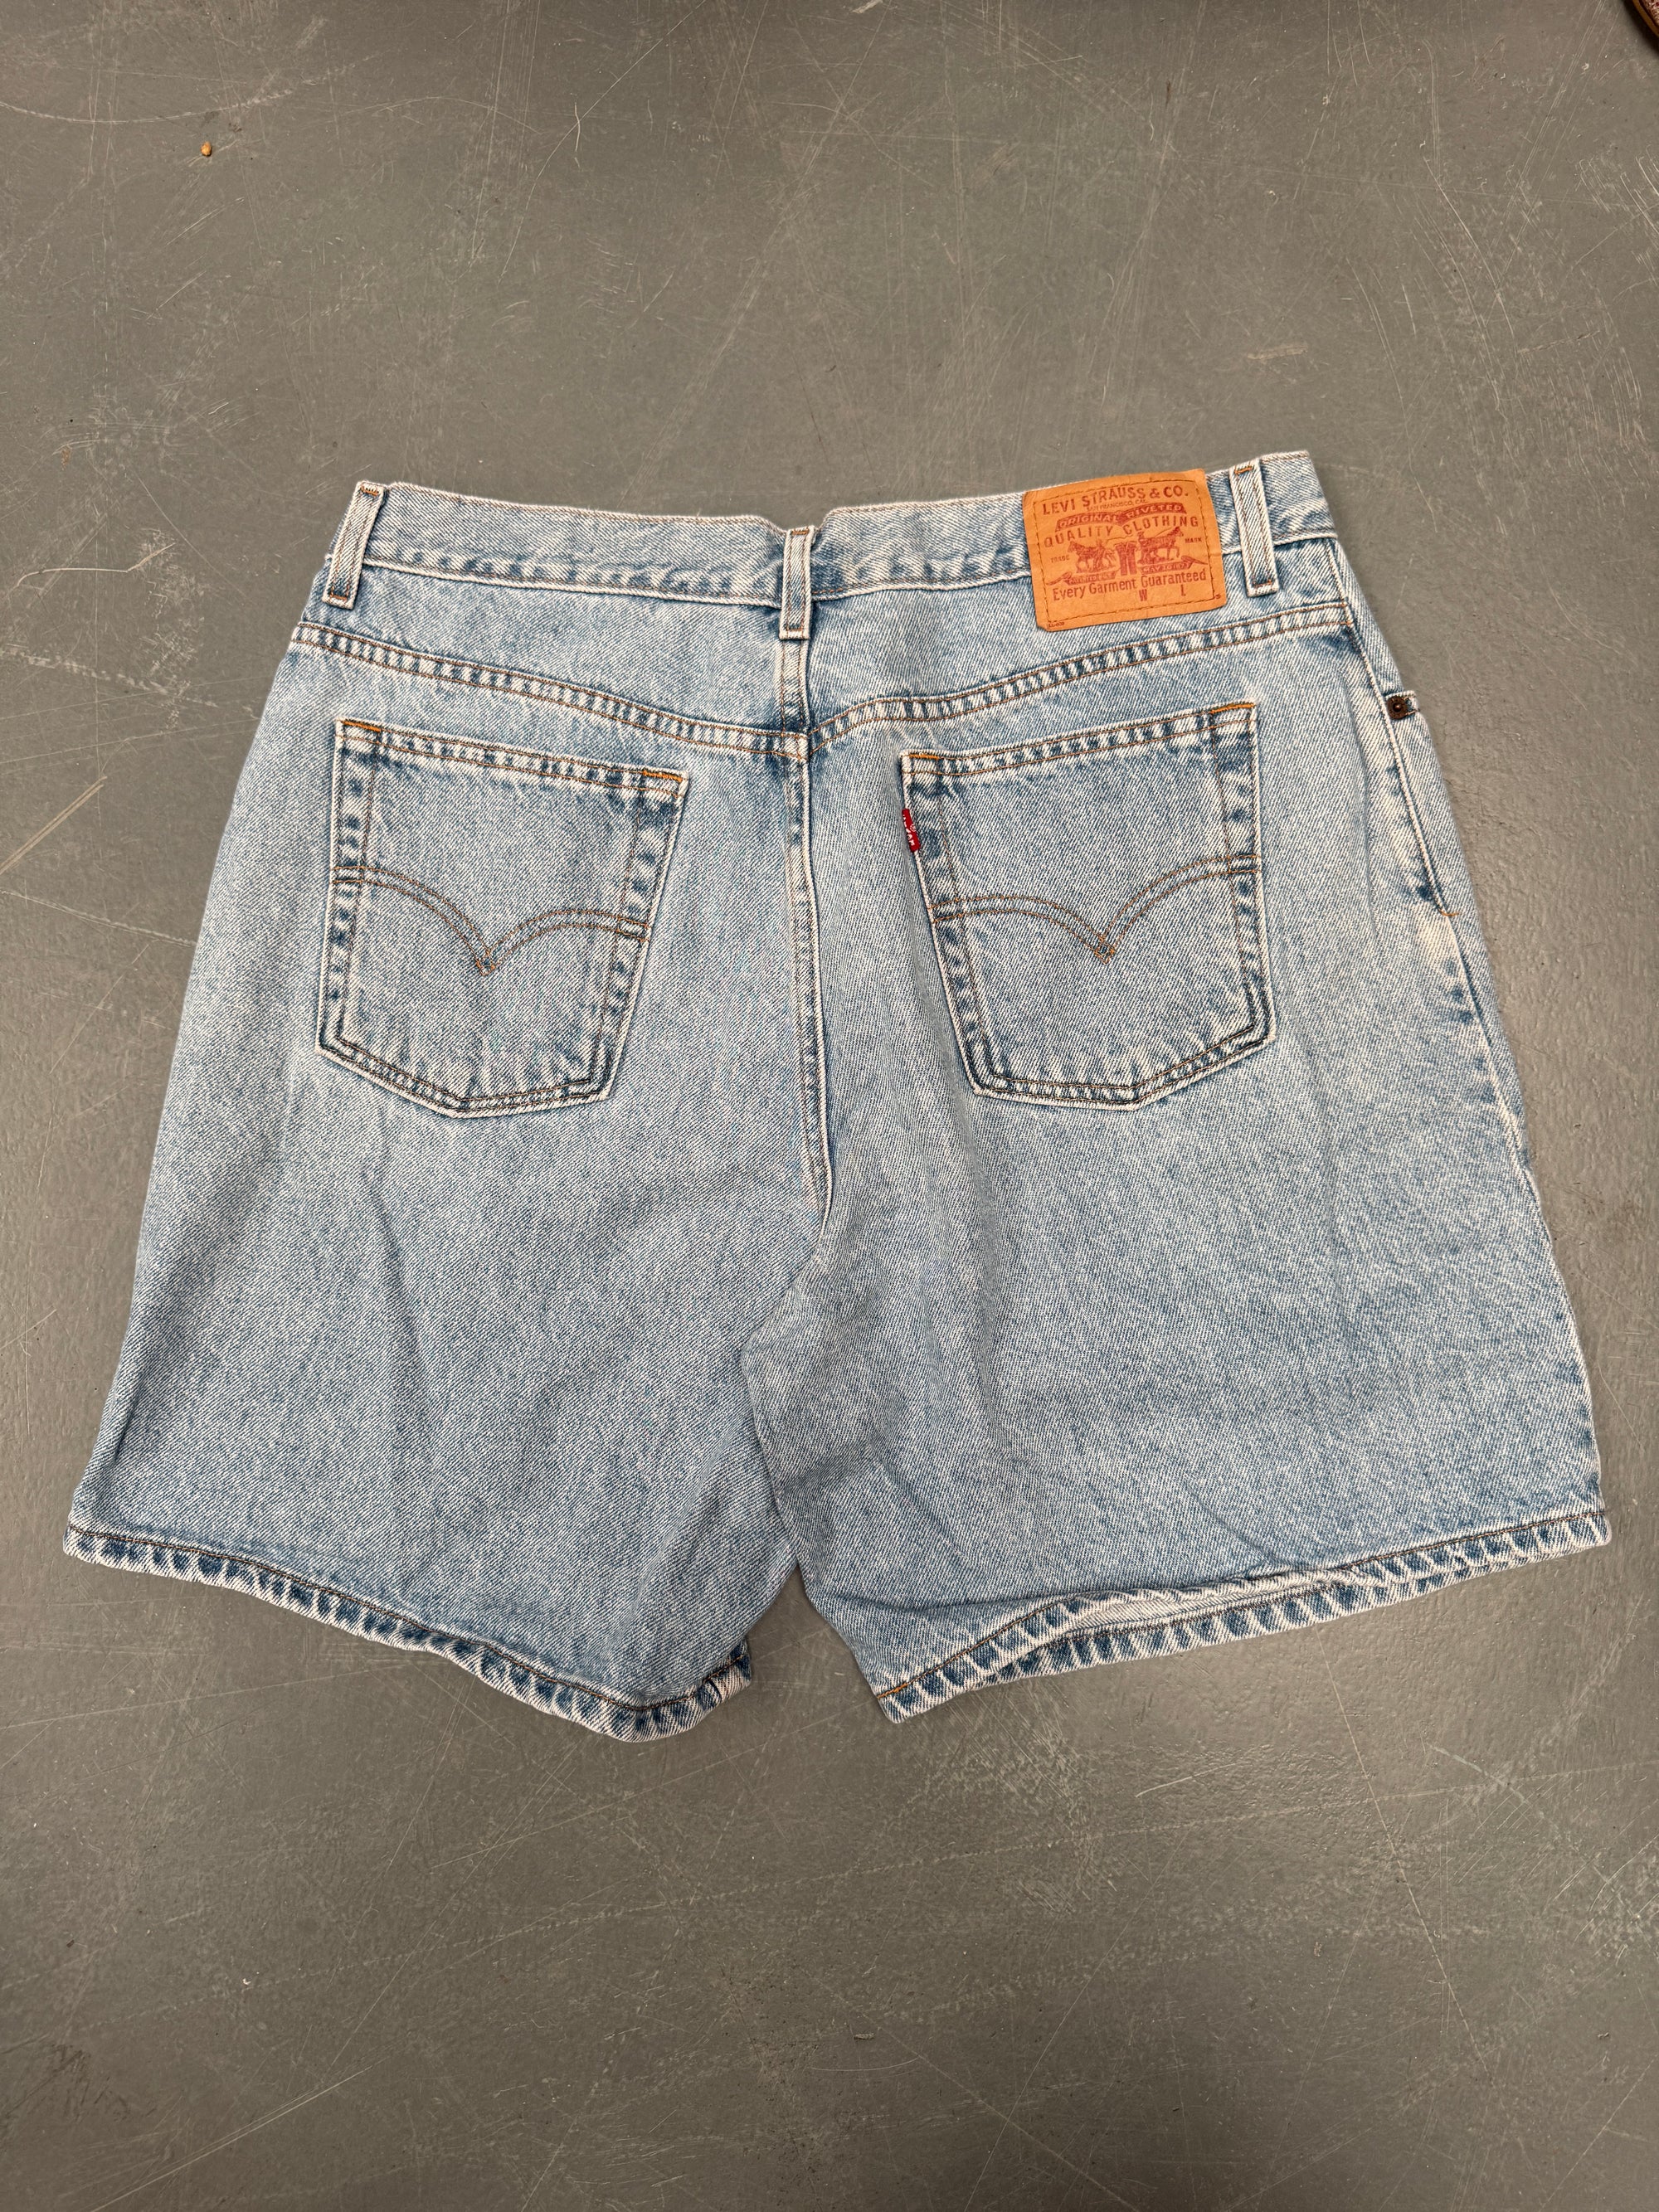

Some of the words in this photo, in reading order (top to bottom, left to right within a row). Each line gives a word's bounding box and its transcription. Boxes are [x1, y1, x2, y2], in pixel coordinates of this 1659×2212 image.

[1042, 500, 1076, 516] LEVI
[1082, 486, 1146, 508] STRAUSS
[1150, 488, 1160, 499] &
[1163, 484, 1189, 498] CO.
[1058, 513, 1120, 528] ORIGINAL
[1126, 503, 1183, 520] RIVETED
[1044, 526, 1114, 548] QUALITY
[1122, 515, 1199, 536] CLOTHING
[1053, 585, 1086, 602] Every
[1089, 578, 1137, 596] Garment
[1141, 568, 1208, 589] Guaranteed
[1138, 590, 1148, 602] W
[1180, 584, 1187, 597] L
